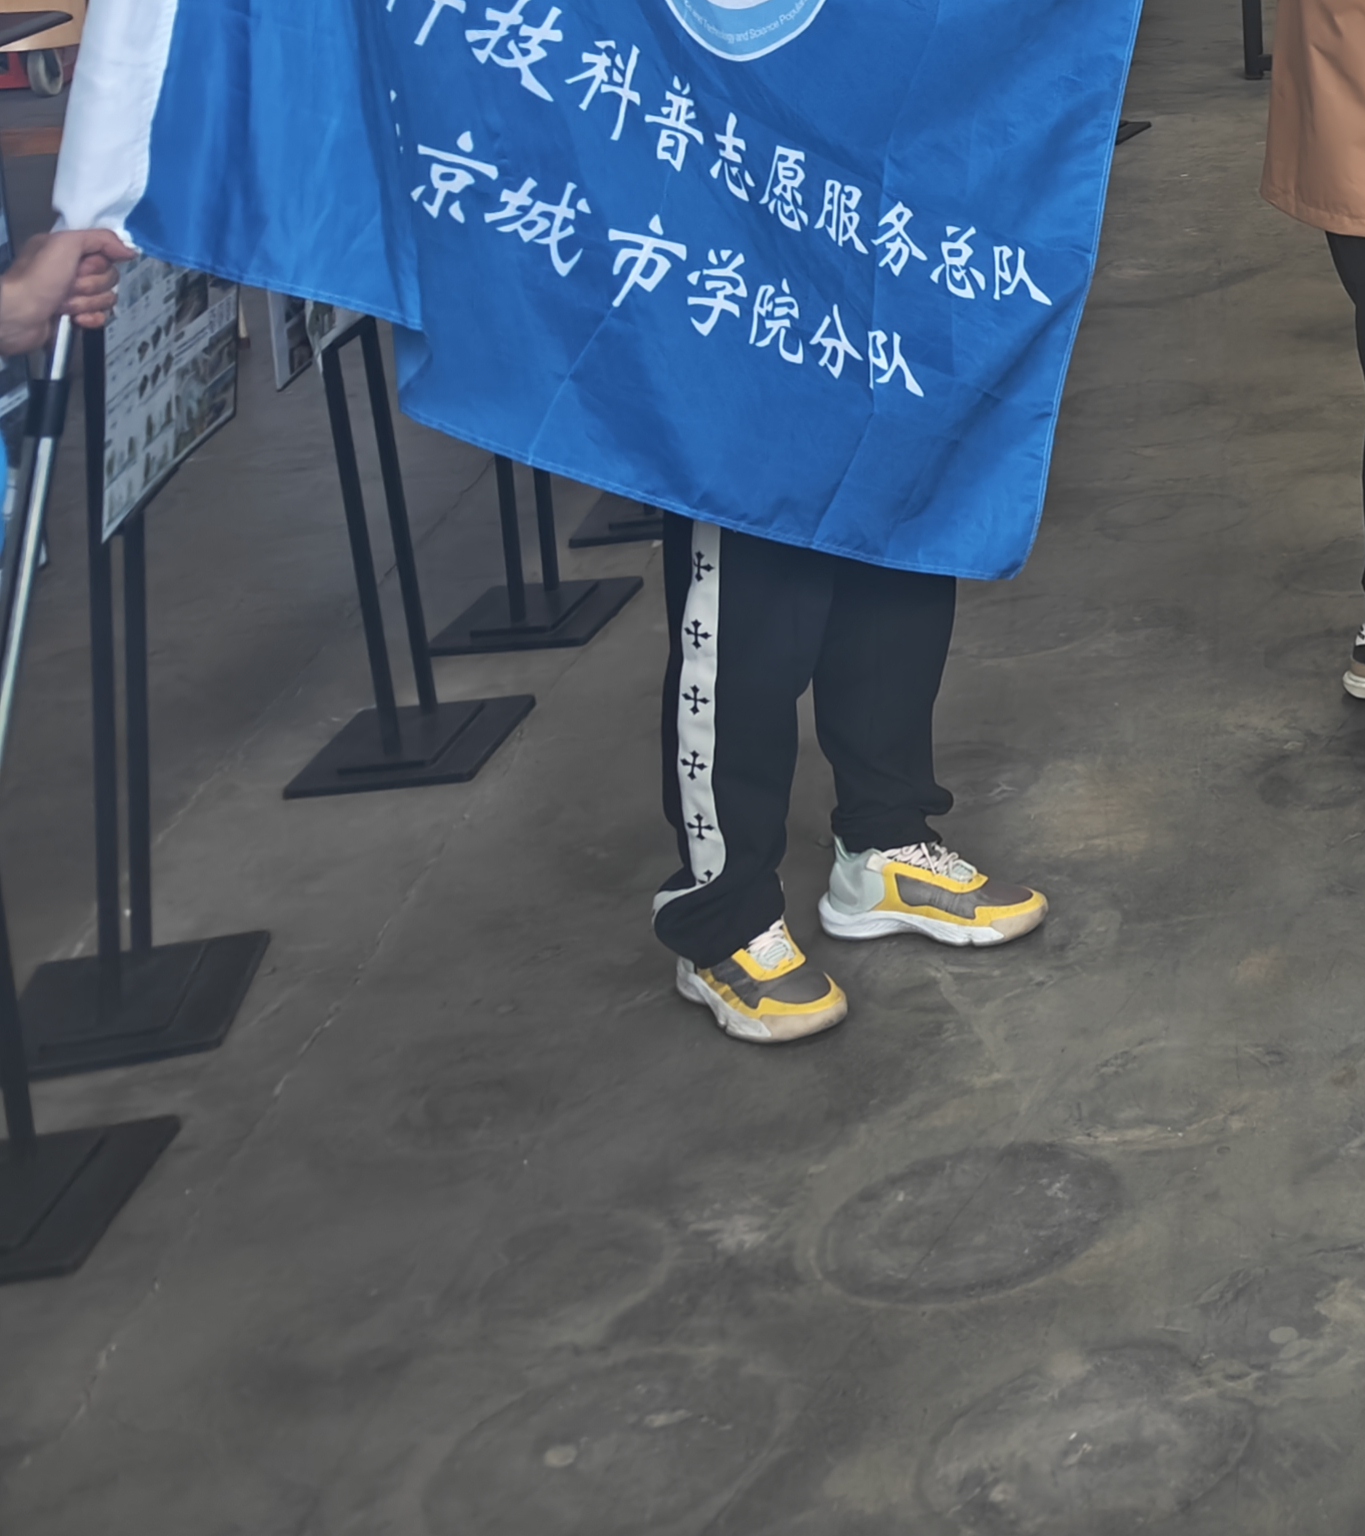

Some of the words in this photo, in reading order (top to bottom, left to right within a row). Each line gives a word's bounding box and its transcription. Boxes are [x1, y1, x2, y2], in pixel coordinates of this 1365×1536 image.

[390, 89, 924, 397] 京城市学院分队
